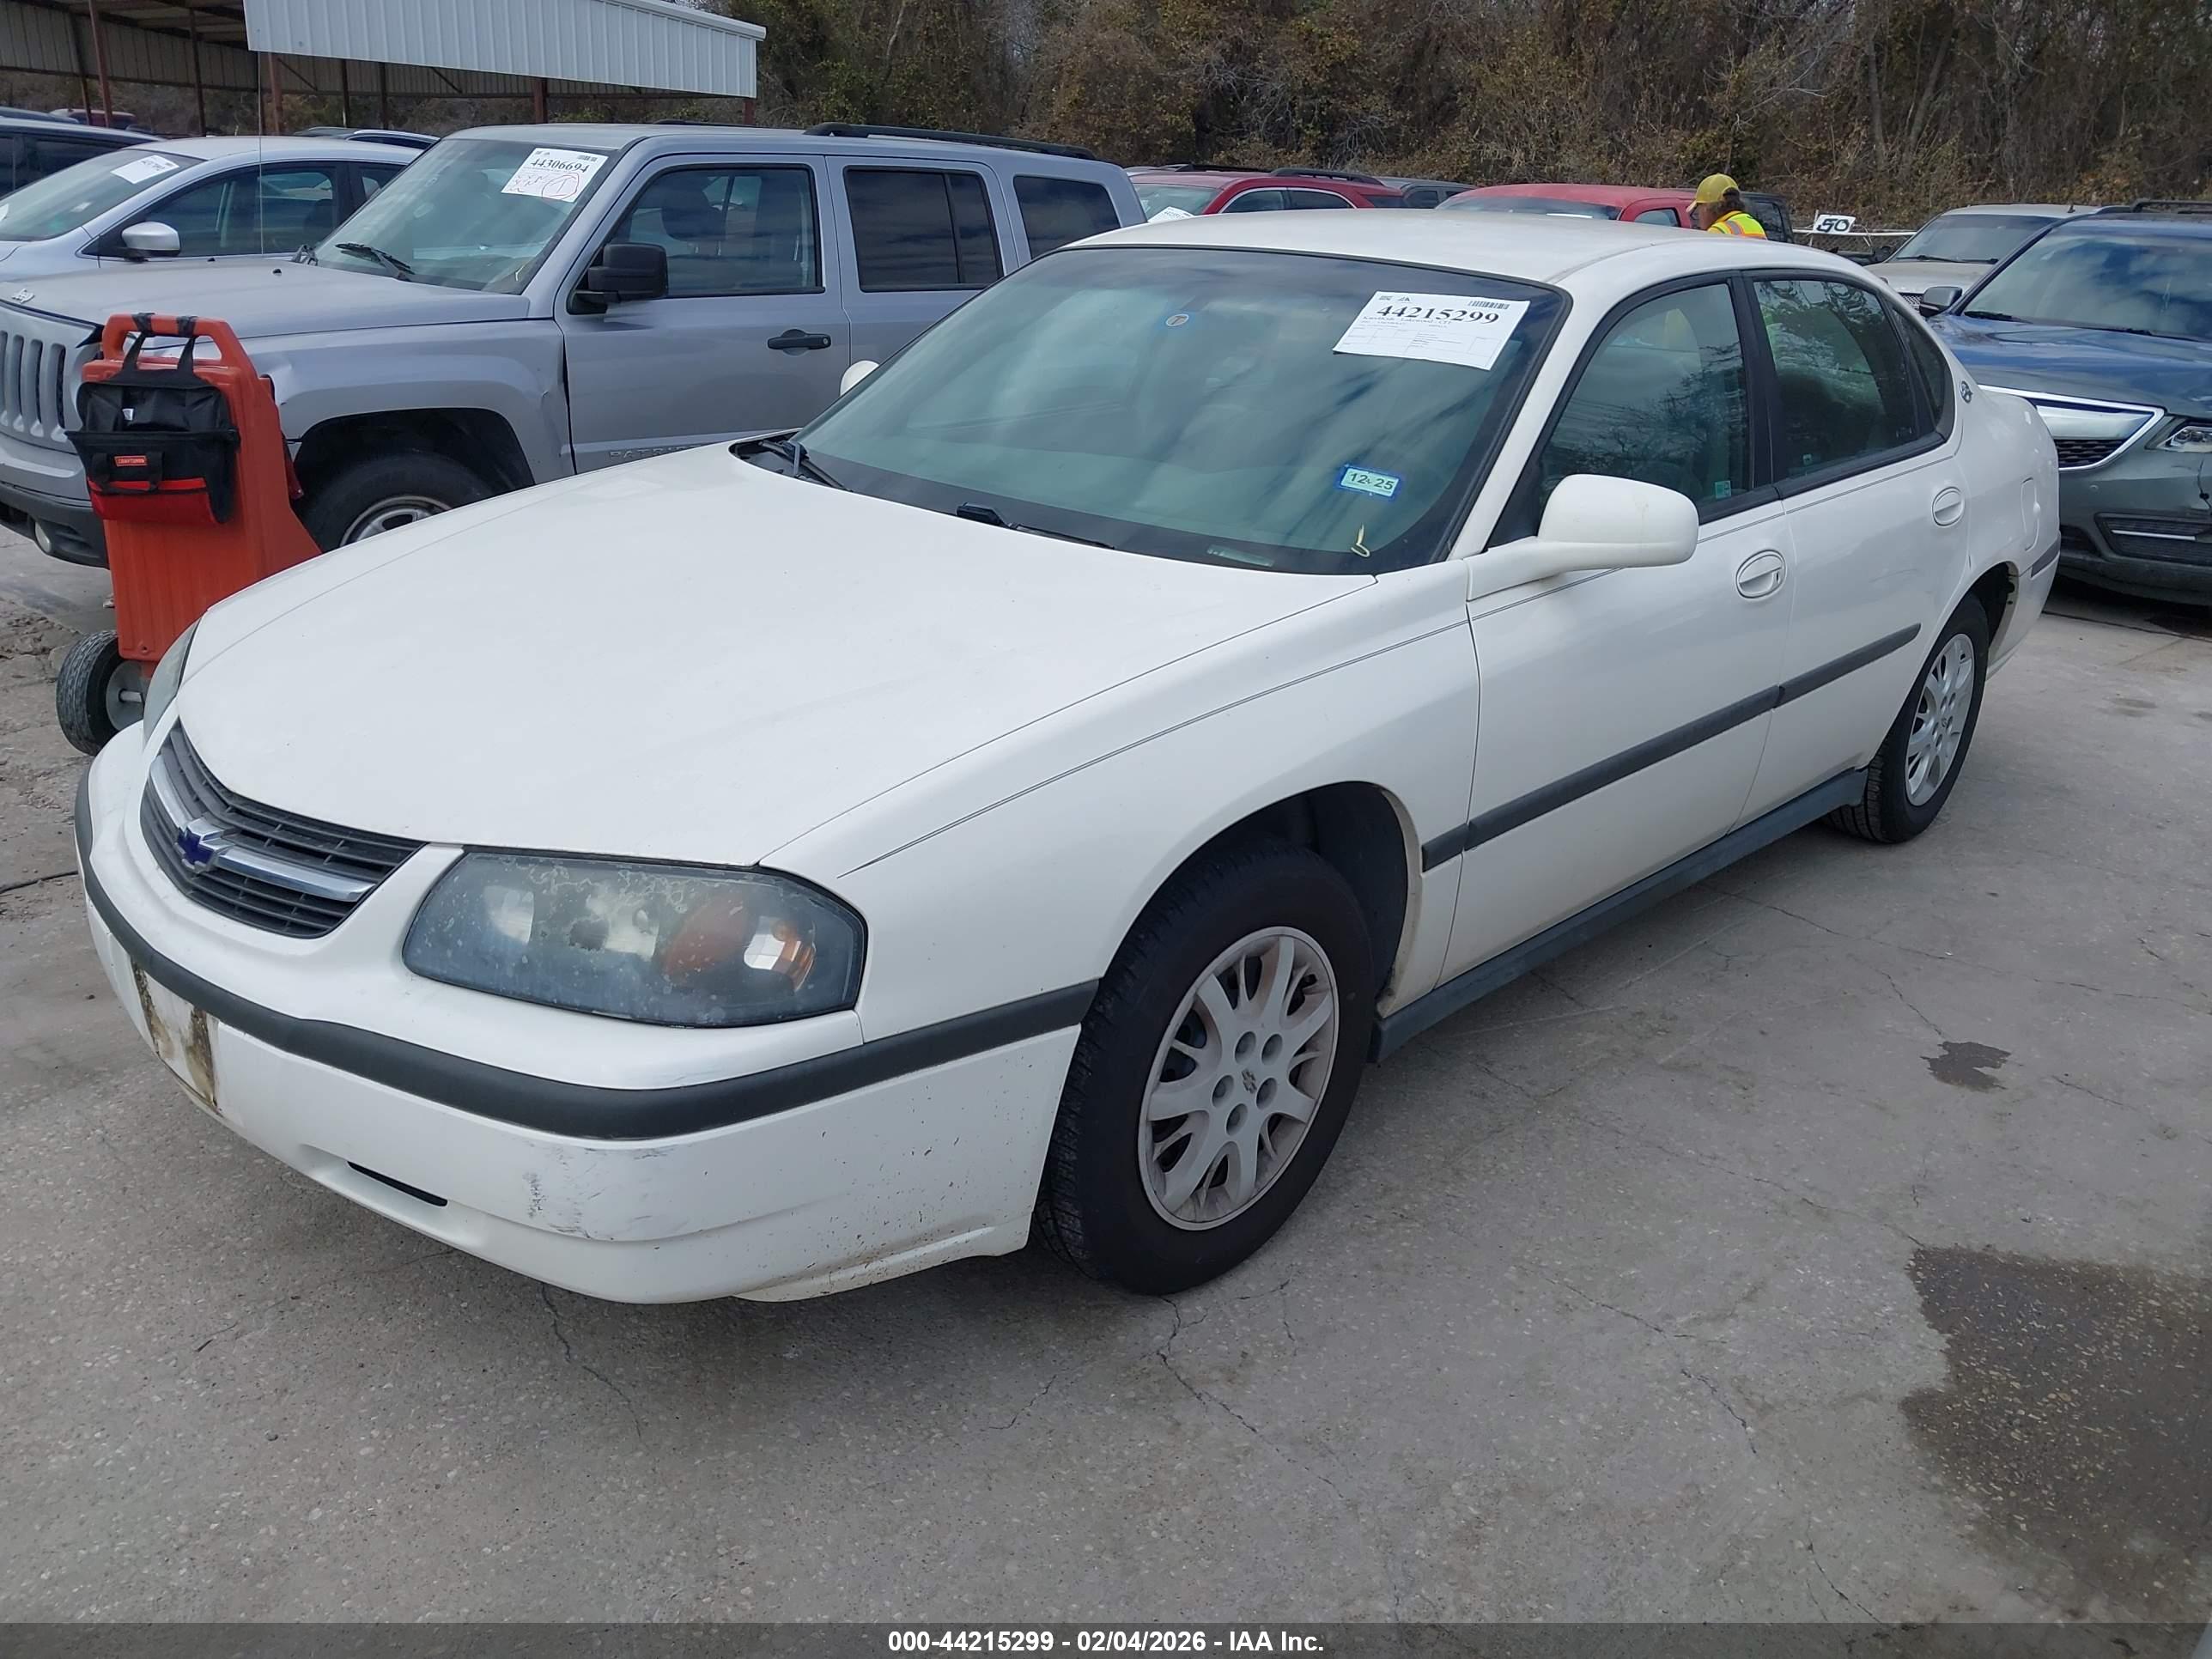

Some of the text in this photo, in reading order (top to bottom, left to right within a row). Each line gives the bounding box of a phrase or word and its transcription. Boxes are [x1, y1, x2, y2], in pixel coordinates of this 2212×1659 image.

[531, 158, 590, 173] 44306694
[1816, 218, 1850, 233] 50
[1376, 305, 1499, 325] 44215299
[1351, 472, 1395, 490] 12 25
